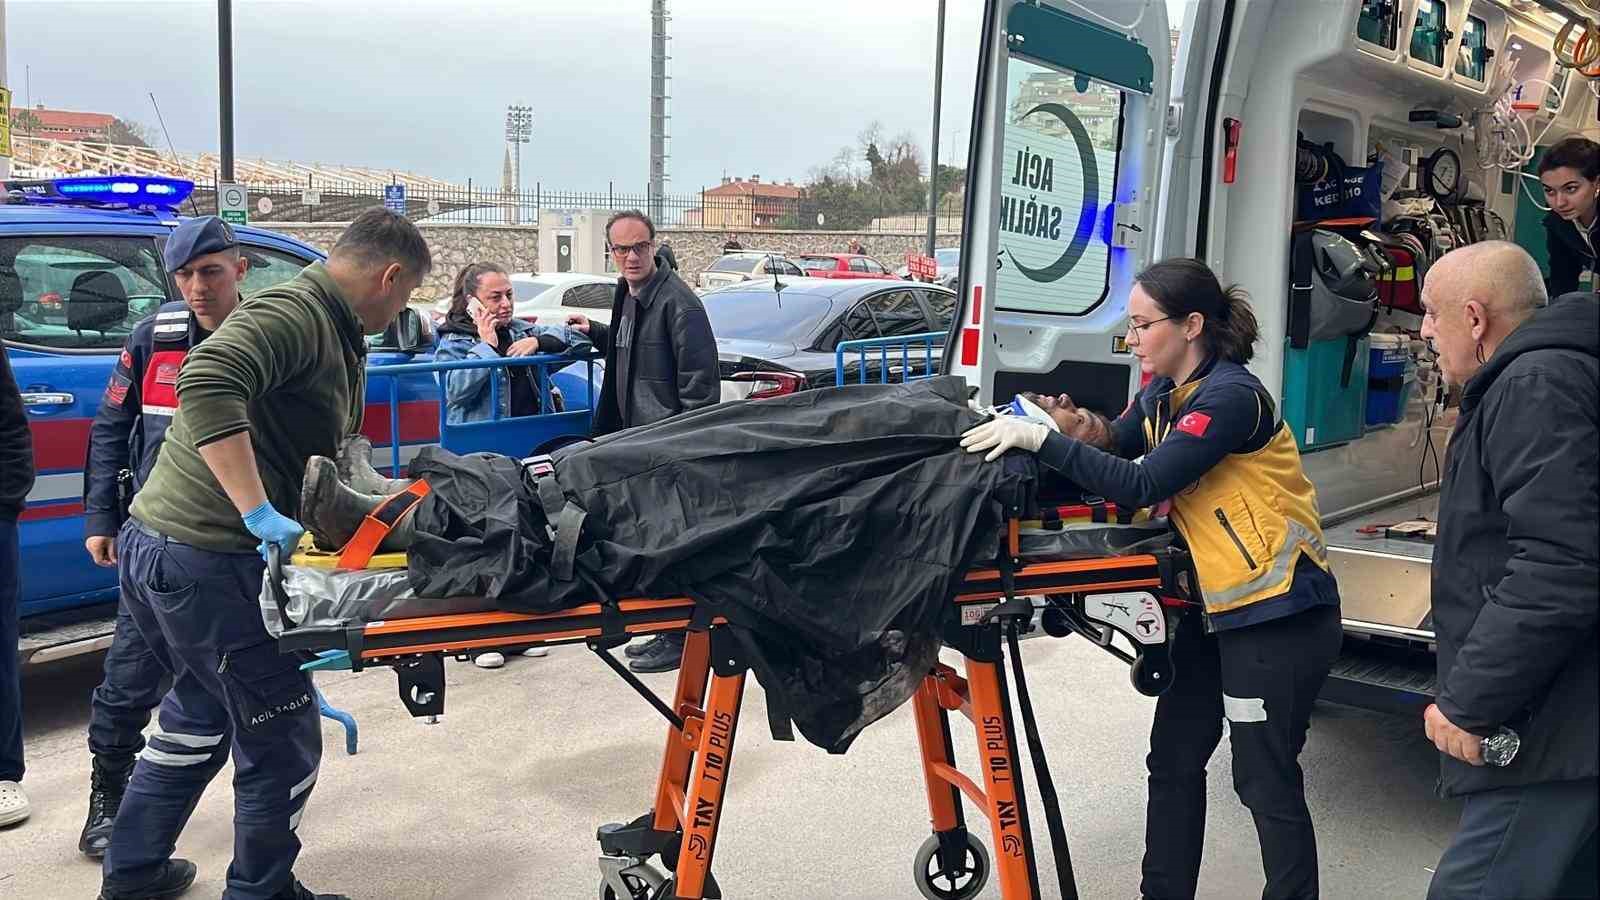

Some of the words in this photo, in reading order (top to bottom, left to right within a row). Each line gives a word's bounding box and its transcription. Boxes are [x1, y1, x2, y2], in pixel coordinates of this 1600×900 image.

[983, 716, 1003, 751] PLUS
[693, 797, 714, 829] TAY
[709, 709, 732, 751] PLUS
[997, 800, 1017, 831] TAY
